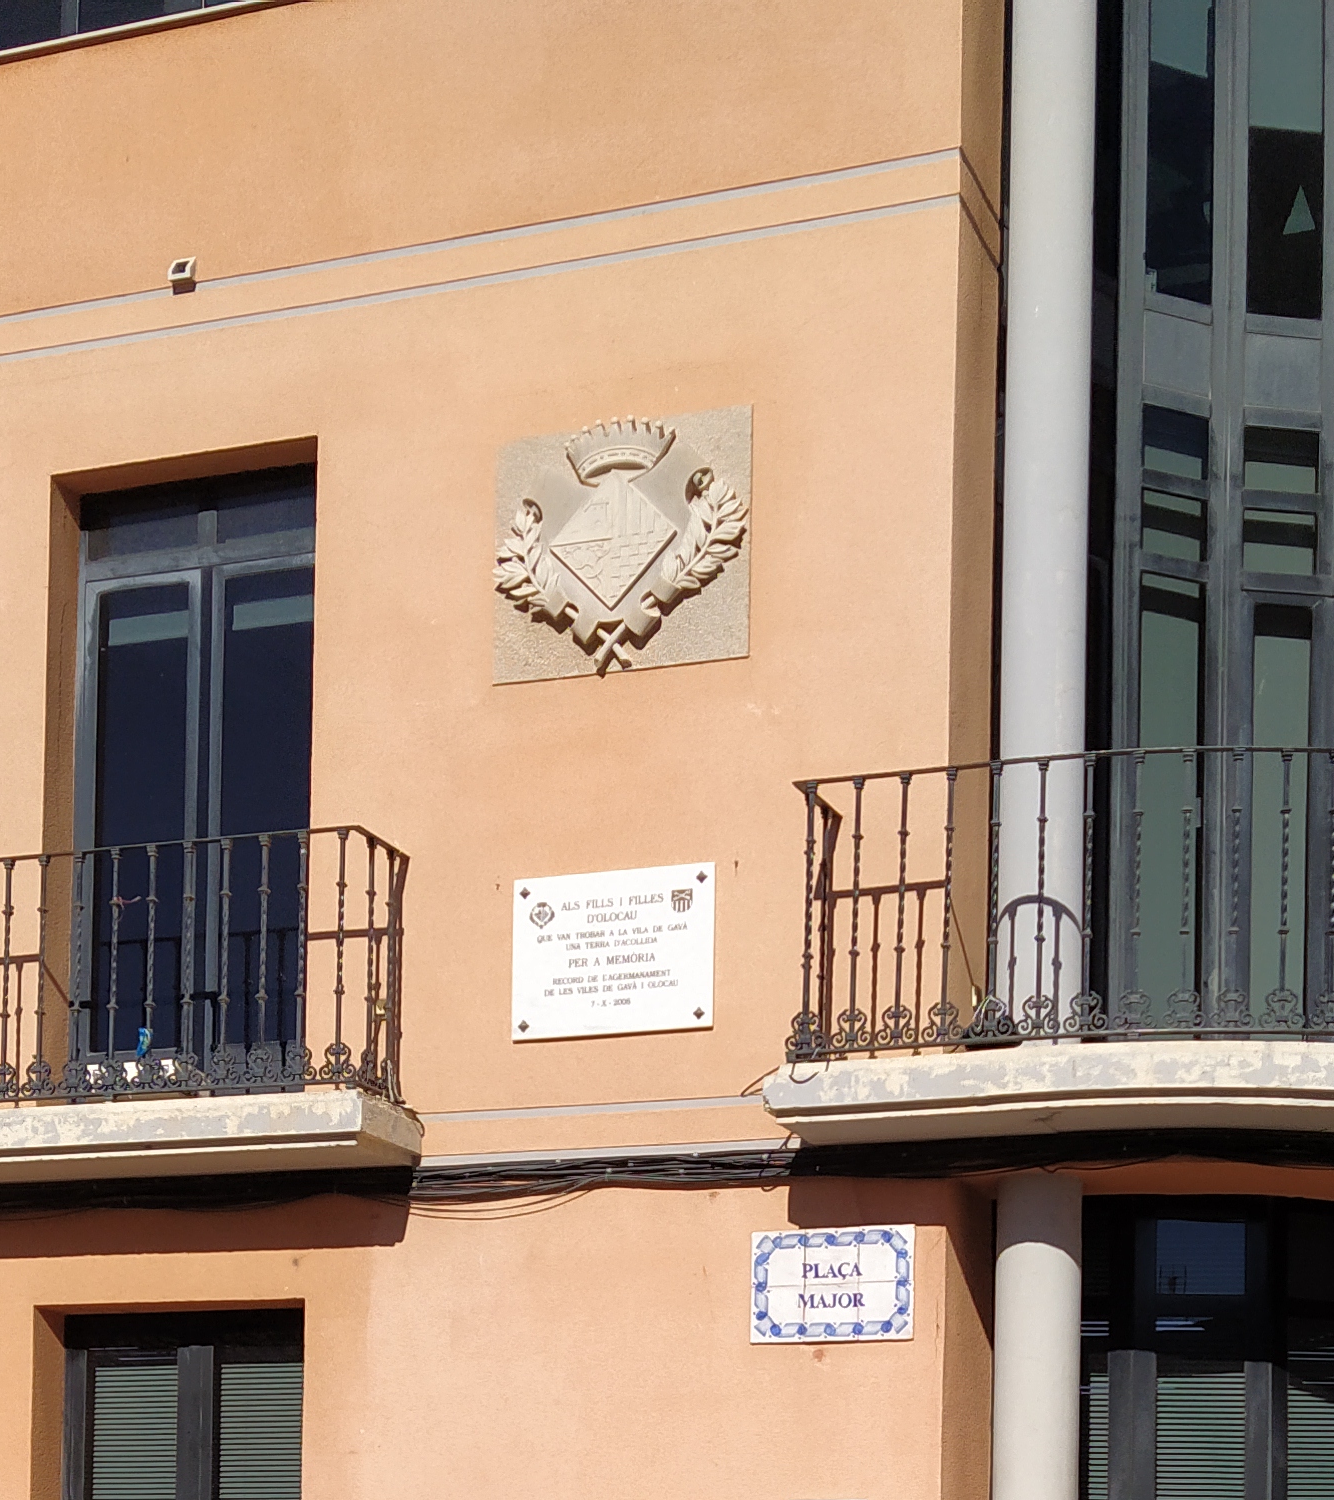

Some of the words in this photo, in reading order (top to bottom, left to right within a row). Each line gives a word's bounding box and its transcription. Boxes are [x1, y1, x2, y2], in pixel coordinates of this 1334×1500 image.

[561, 902, 580, 911] ALS
[586, 898, 614, 909] FILLS
[619, 897, 623, 906] I
[628, 893, 664, 906] FILLES
[587, 910, 637, 923] D'OLOCAU
[537, 934, 553, 943] QUE
[557, 933, 571, 941] VAN
[576, 930, 605, 939] TROBAR
[609, 929, 615, 937] A
[618, 928, 628, 936] LA
[632, 926, 648, 935] VILA
[653, 924, 663, 933] DE
[667, 921, 688, 931] GAVÀ
[566, 943, 581, 951] UNA
[585, 940, 610, 949] TERRA
[614, 936, 658, 947] D'ACOLLIDA
[568, 958, 588, 968] PER
[593, 957, 600, 966] A
[606, 952, 656, 965] MEMÒRIA
[544, 989, 555, 997] DE
[559, 987, 573, 995] LES
[577, 986, 599, 995] VILES
[603, 985, 614, 993] DE
[617, 982, 637, 991] GAVÀ
[641, 981, 645, 989] I
[648, 979, 679, 988] OLOCAU
[552, 976, 584, 985] RECORD
[801, 1262, 863, 1280] PLAÇA
[798, 1292, 865, 1309] MAJOR
